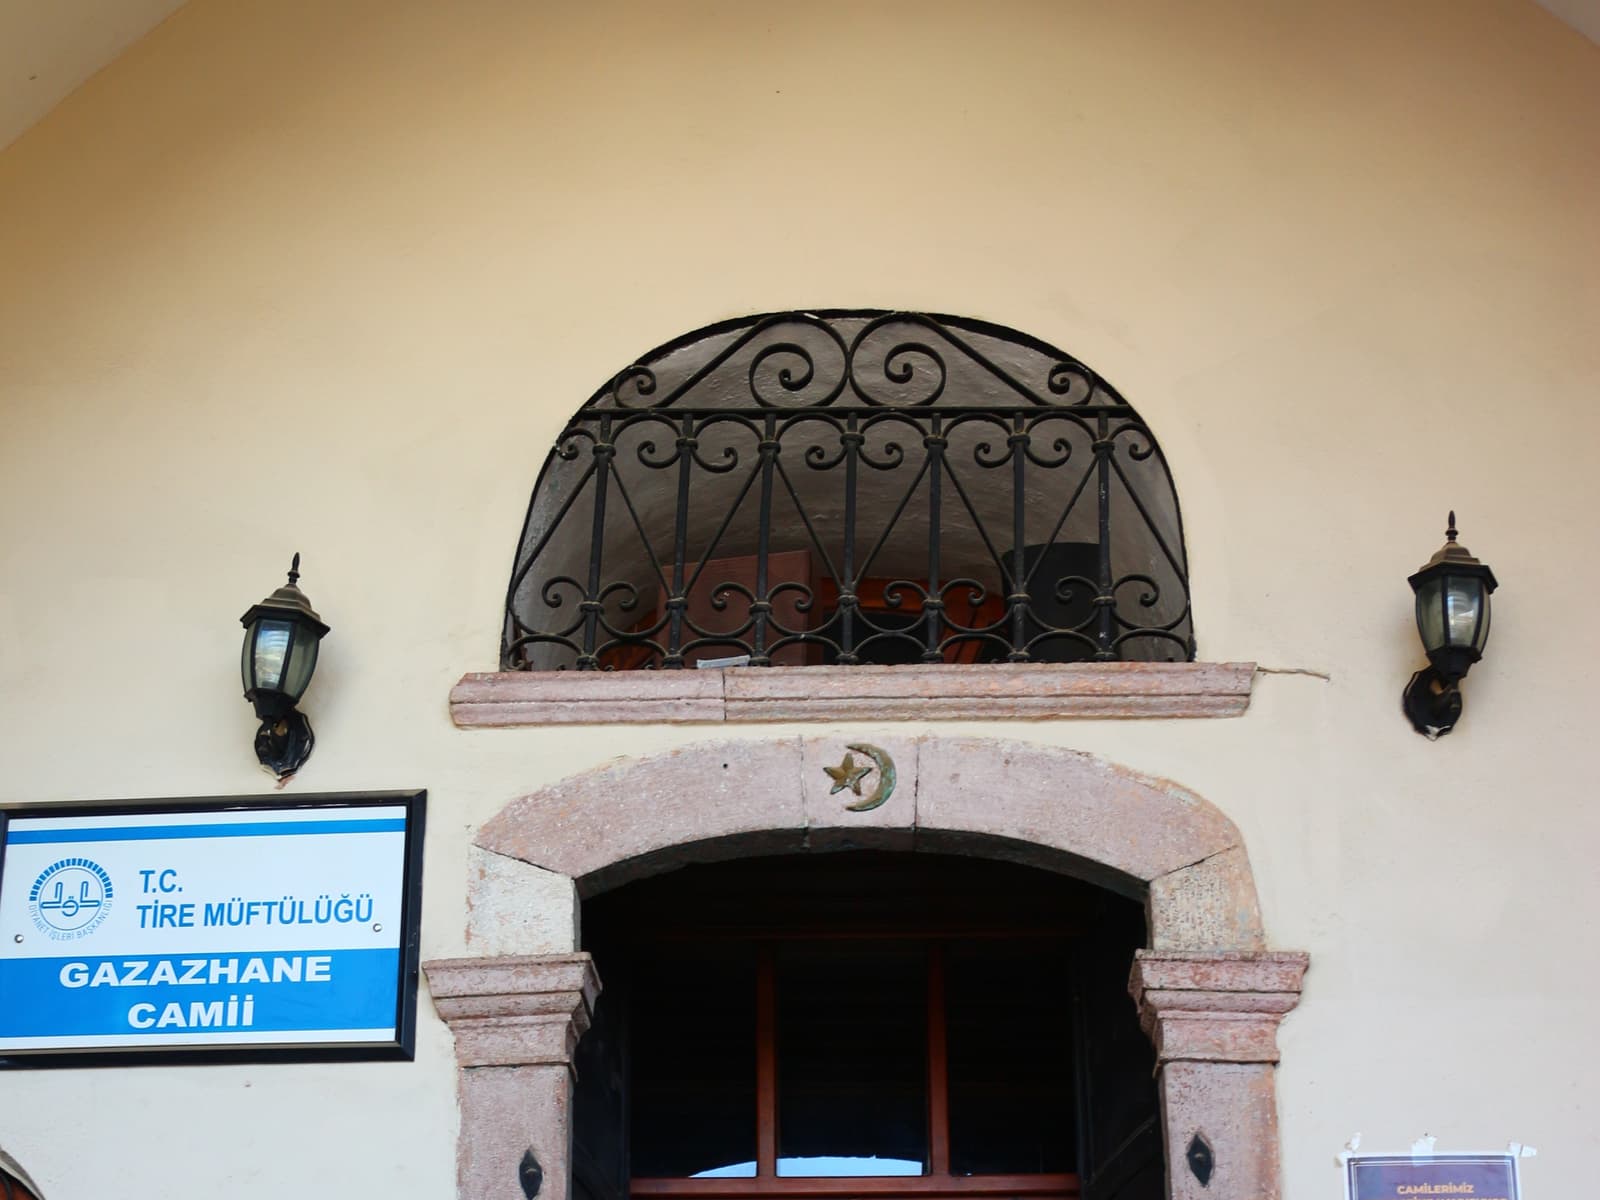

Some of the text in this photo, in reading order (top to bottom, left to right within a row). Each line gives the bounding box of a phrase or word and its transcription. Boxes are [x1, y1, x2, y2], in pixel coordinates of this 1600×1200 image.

[139, 869, 183, 893] T.C.
[136, 893, 374, 929] TİRE MÜFTÜLÜĞÜ
[59, 956, 332, 988] GAZAZHANE
[127, 994, 254, 1028] CAMİİ
[1396, 1182, 1474, 1195] CAMİLERİMİZ
